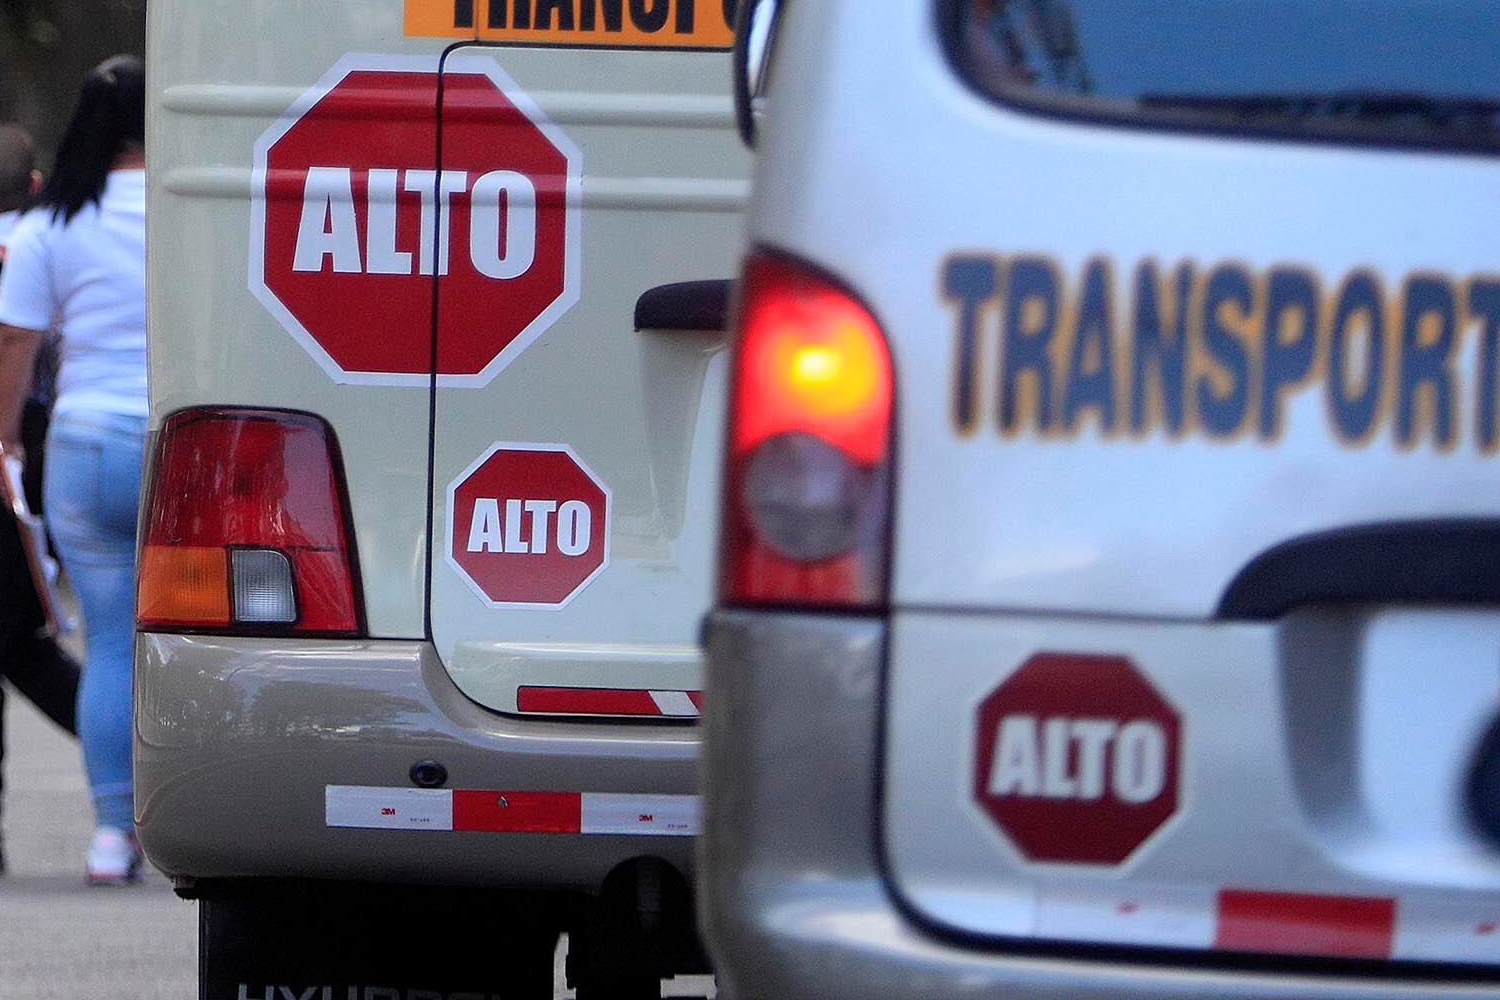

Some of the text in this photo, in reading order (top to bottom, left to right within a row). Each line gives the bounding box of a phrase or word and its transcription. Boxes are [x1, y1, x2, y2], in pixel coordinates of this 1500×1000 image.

[292, 166, 537, 280] ALTO
[467, 498, 592, 556] ALTO
[989, 714, 1166, 804] ALTO
[381, 808, 396, 816] 3M
[638, 814, 653, 822] 3M
